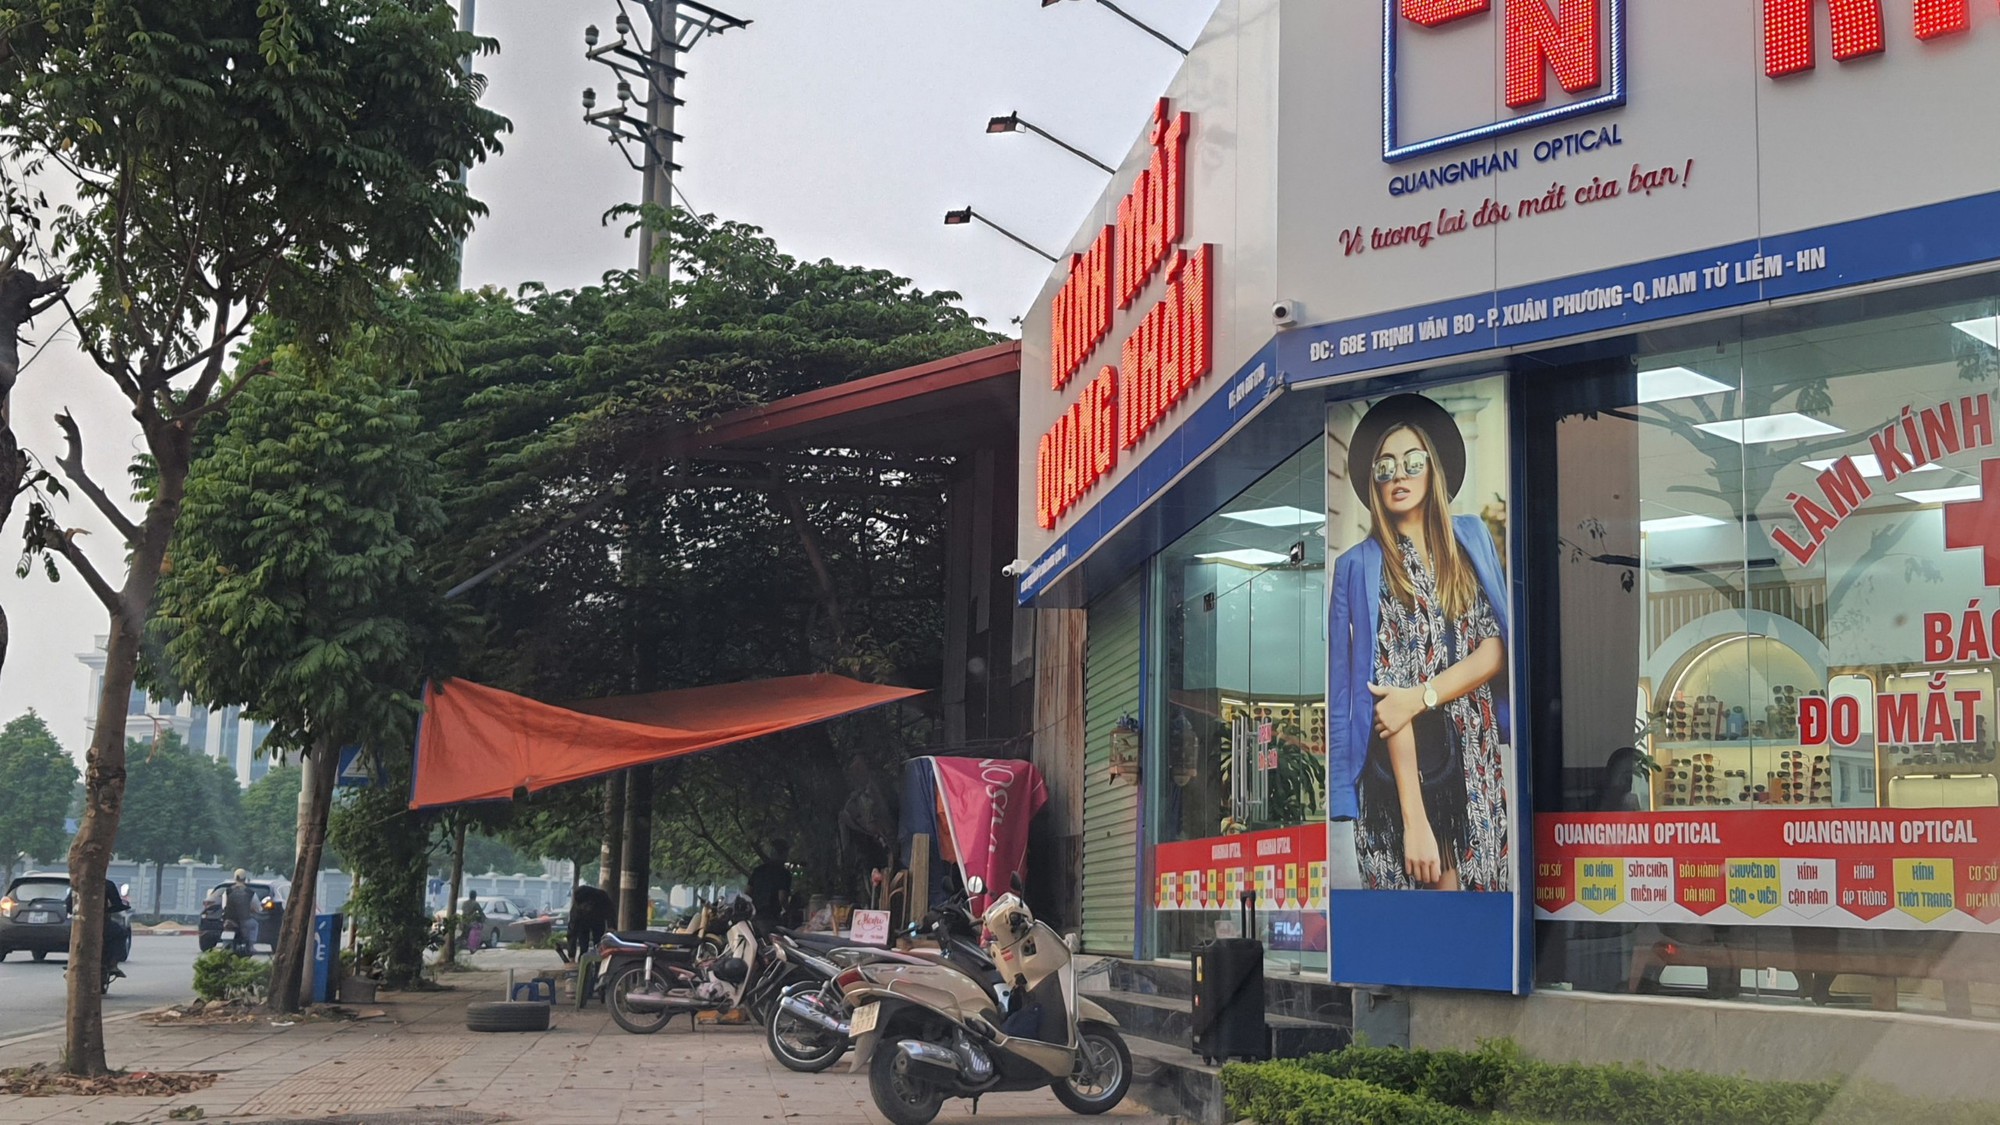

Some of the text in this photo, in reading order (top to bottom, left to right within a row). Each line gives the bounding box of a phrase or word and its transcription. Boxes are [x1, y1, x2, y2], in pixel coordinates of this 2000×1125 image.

[1388, 124, 1622, 196] QUANGNHAN OPTICAL
[1435, 208, 1467, 235] lai
[1517, 181, 1567, 218] mắt
[1574, 177, 1620, 204] của
[1051, 224, 1115, 392] KÍNH
[1310, 342, 1335, 362] ĐC:
[1339, 334, 1366, 354] 68E
[1371, 323, 1414, 351] TRỊNH
[1418, 315, 1449, 341] VĂN
[1702, 261, 1729, 290] TỪ
[1735, 253, 1783, 284] LIÊM
[1037, 365, 1119, 530] QUANG
[1770, 392, 1994, 567] LÀM KÍNH
[1923, 599, 2000, 665] BÁ
[1797, 694, 1861, 746] ĐO
[1876, 671, 1982, 746] MẮT
[1554, 822, 1721, 847] QUANGNHAN OPTICAL
[1783, 819, 1978, 846] QUANGNHAN OPTICAL
[1729, 862, 1762, 879] CHUYÊN
[1797, 861, 1818, 880] KÍNH
[1853, 862, 1875, 880] KÍNH
[1912, 861, 1935, 881] KÍNH
[1603, 884, 1617, 901] PHÍ
[1631, 884, 1667, 902] MIỄN PHÍ
[1857, 887, 1887, 907] TRÒNG
[1921, 891, 1953, 909] TRANG
[1274, 921, 1304, 936] FILA
